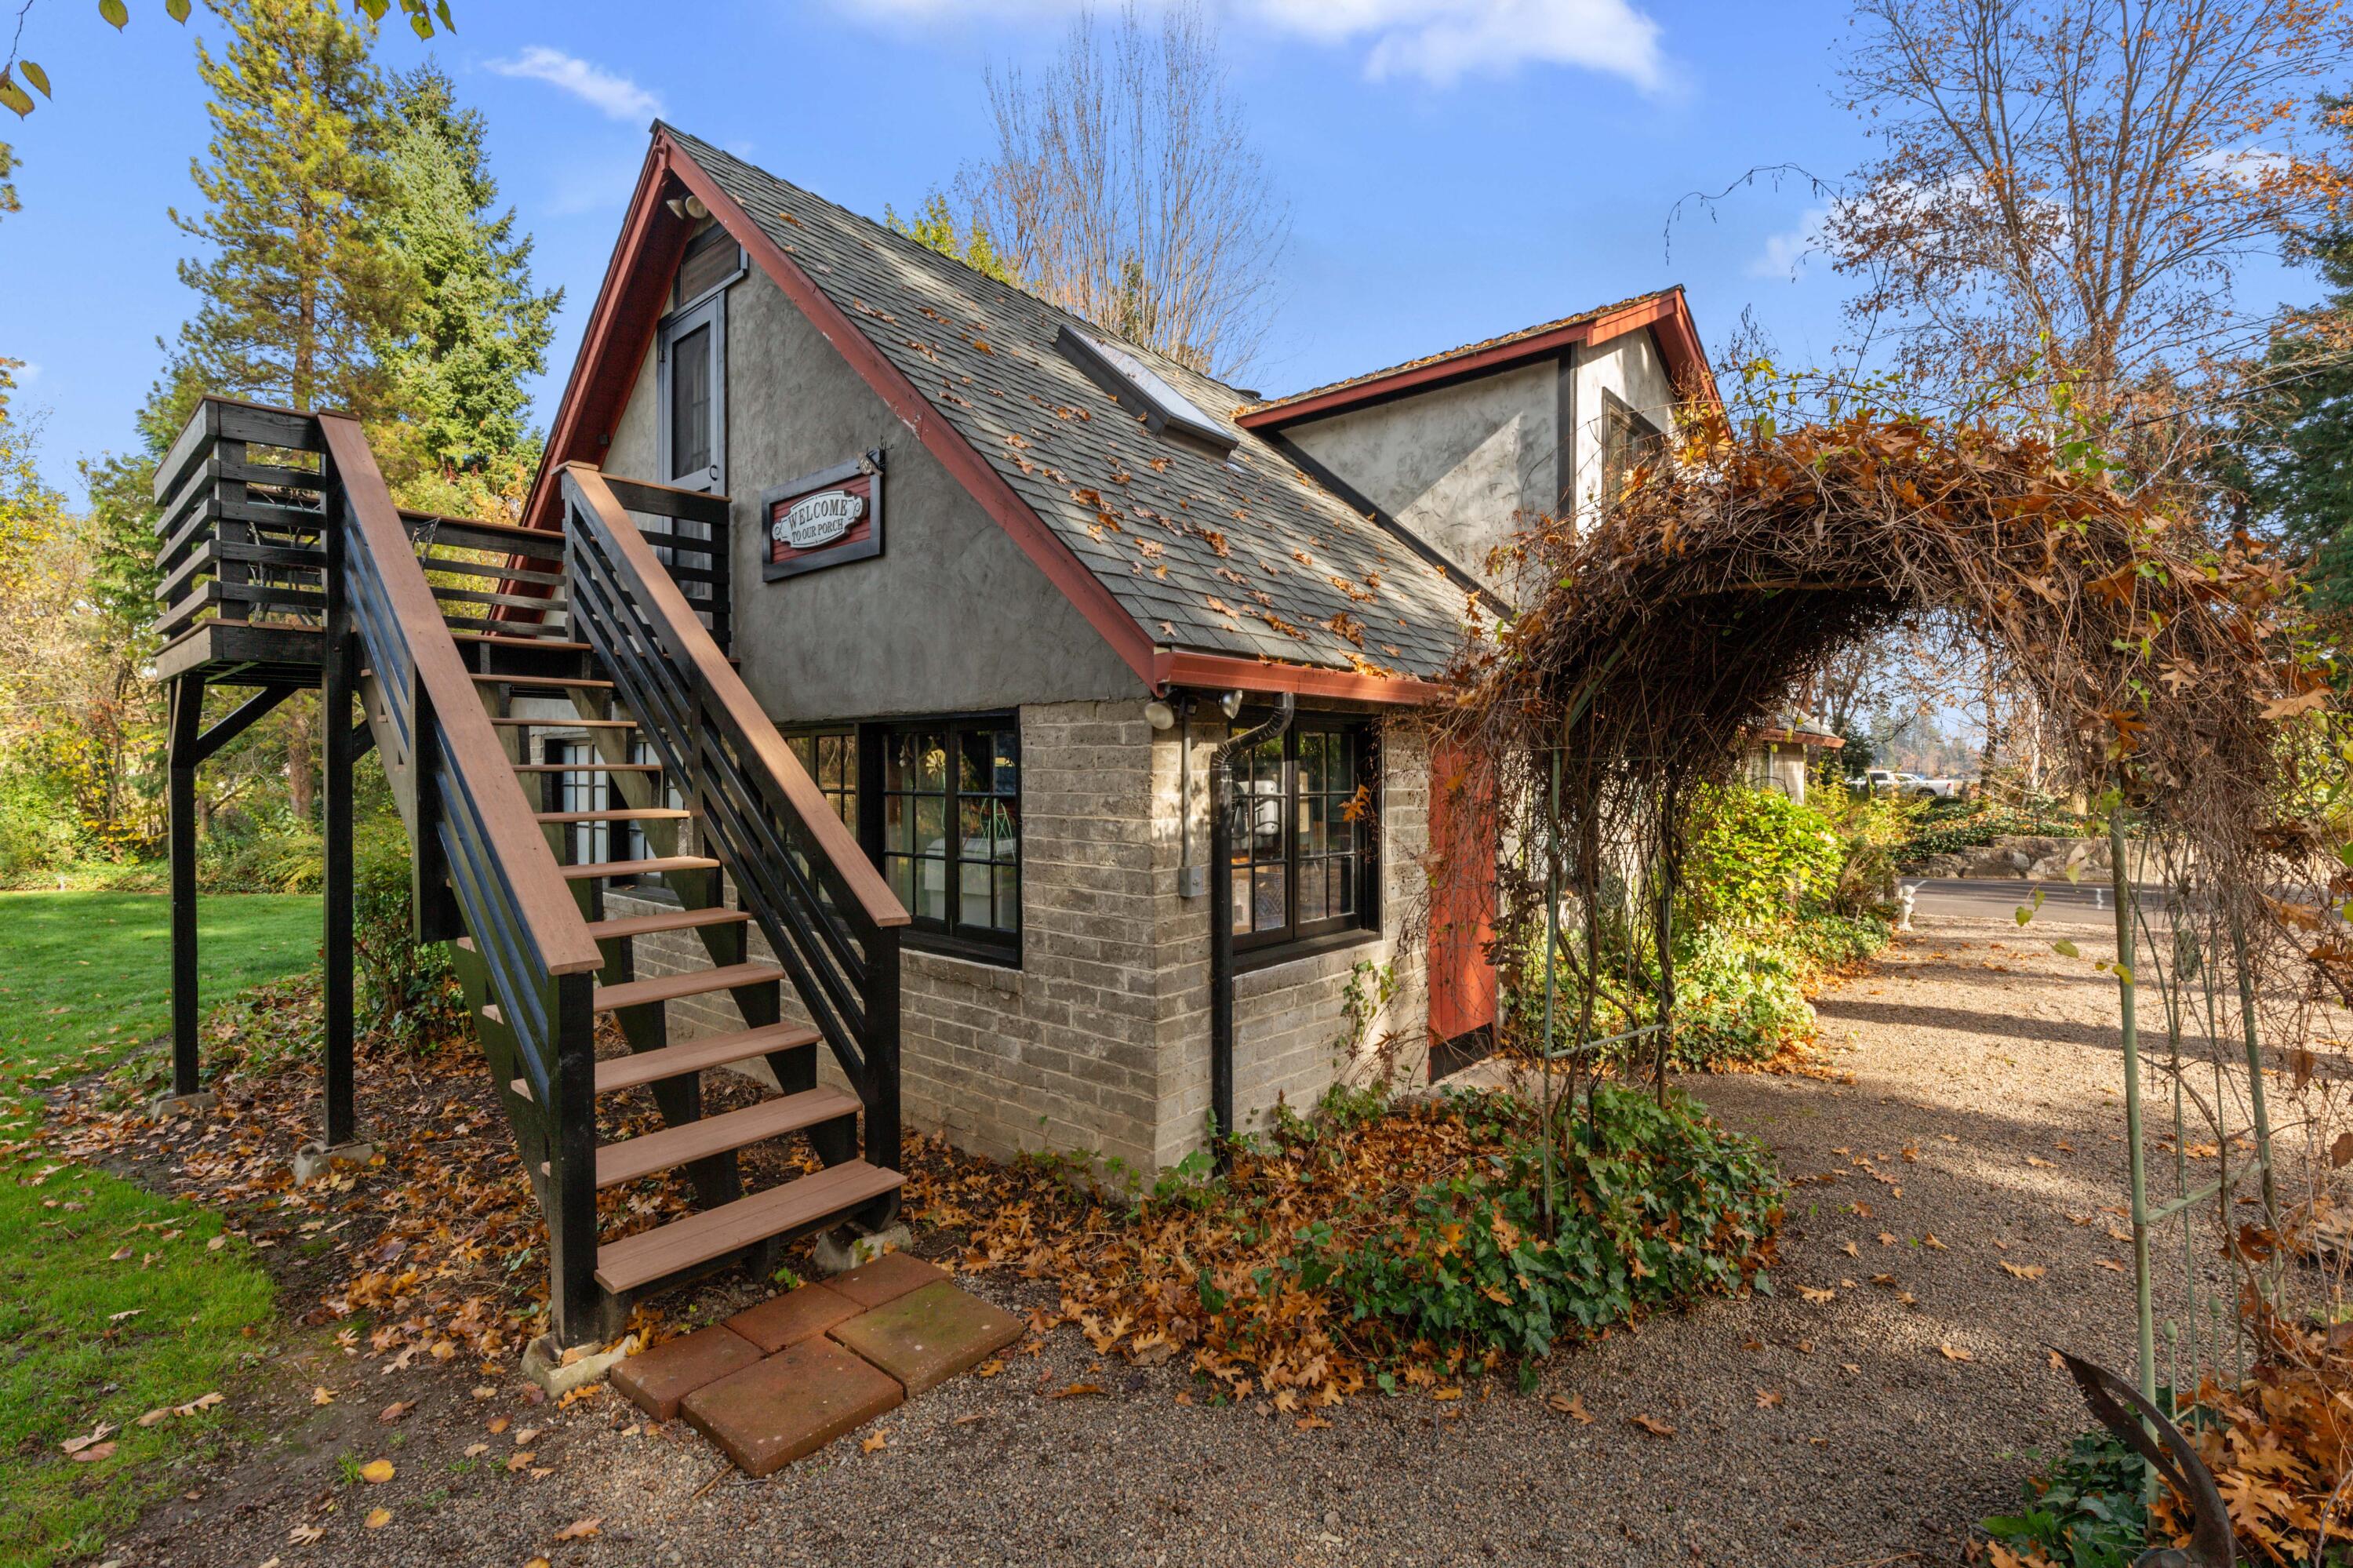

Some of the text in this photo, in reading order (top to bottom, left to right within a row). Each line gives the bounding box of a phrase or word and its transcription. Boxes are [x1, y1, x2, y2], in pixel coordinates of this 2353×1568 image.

[788, 499, 847, 530] WELCOME
[792, 518, 843, 543] TO OUR PORCH
